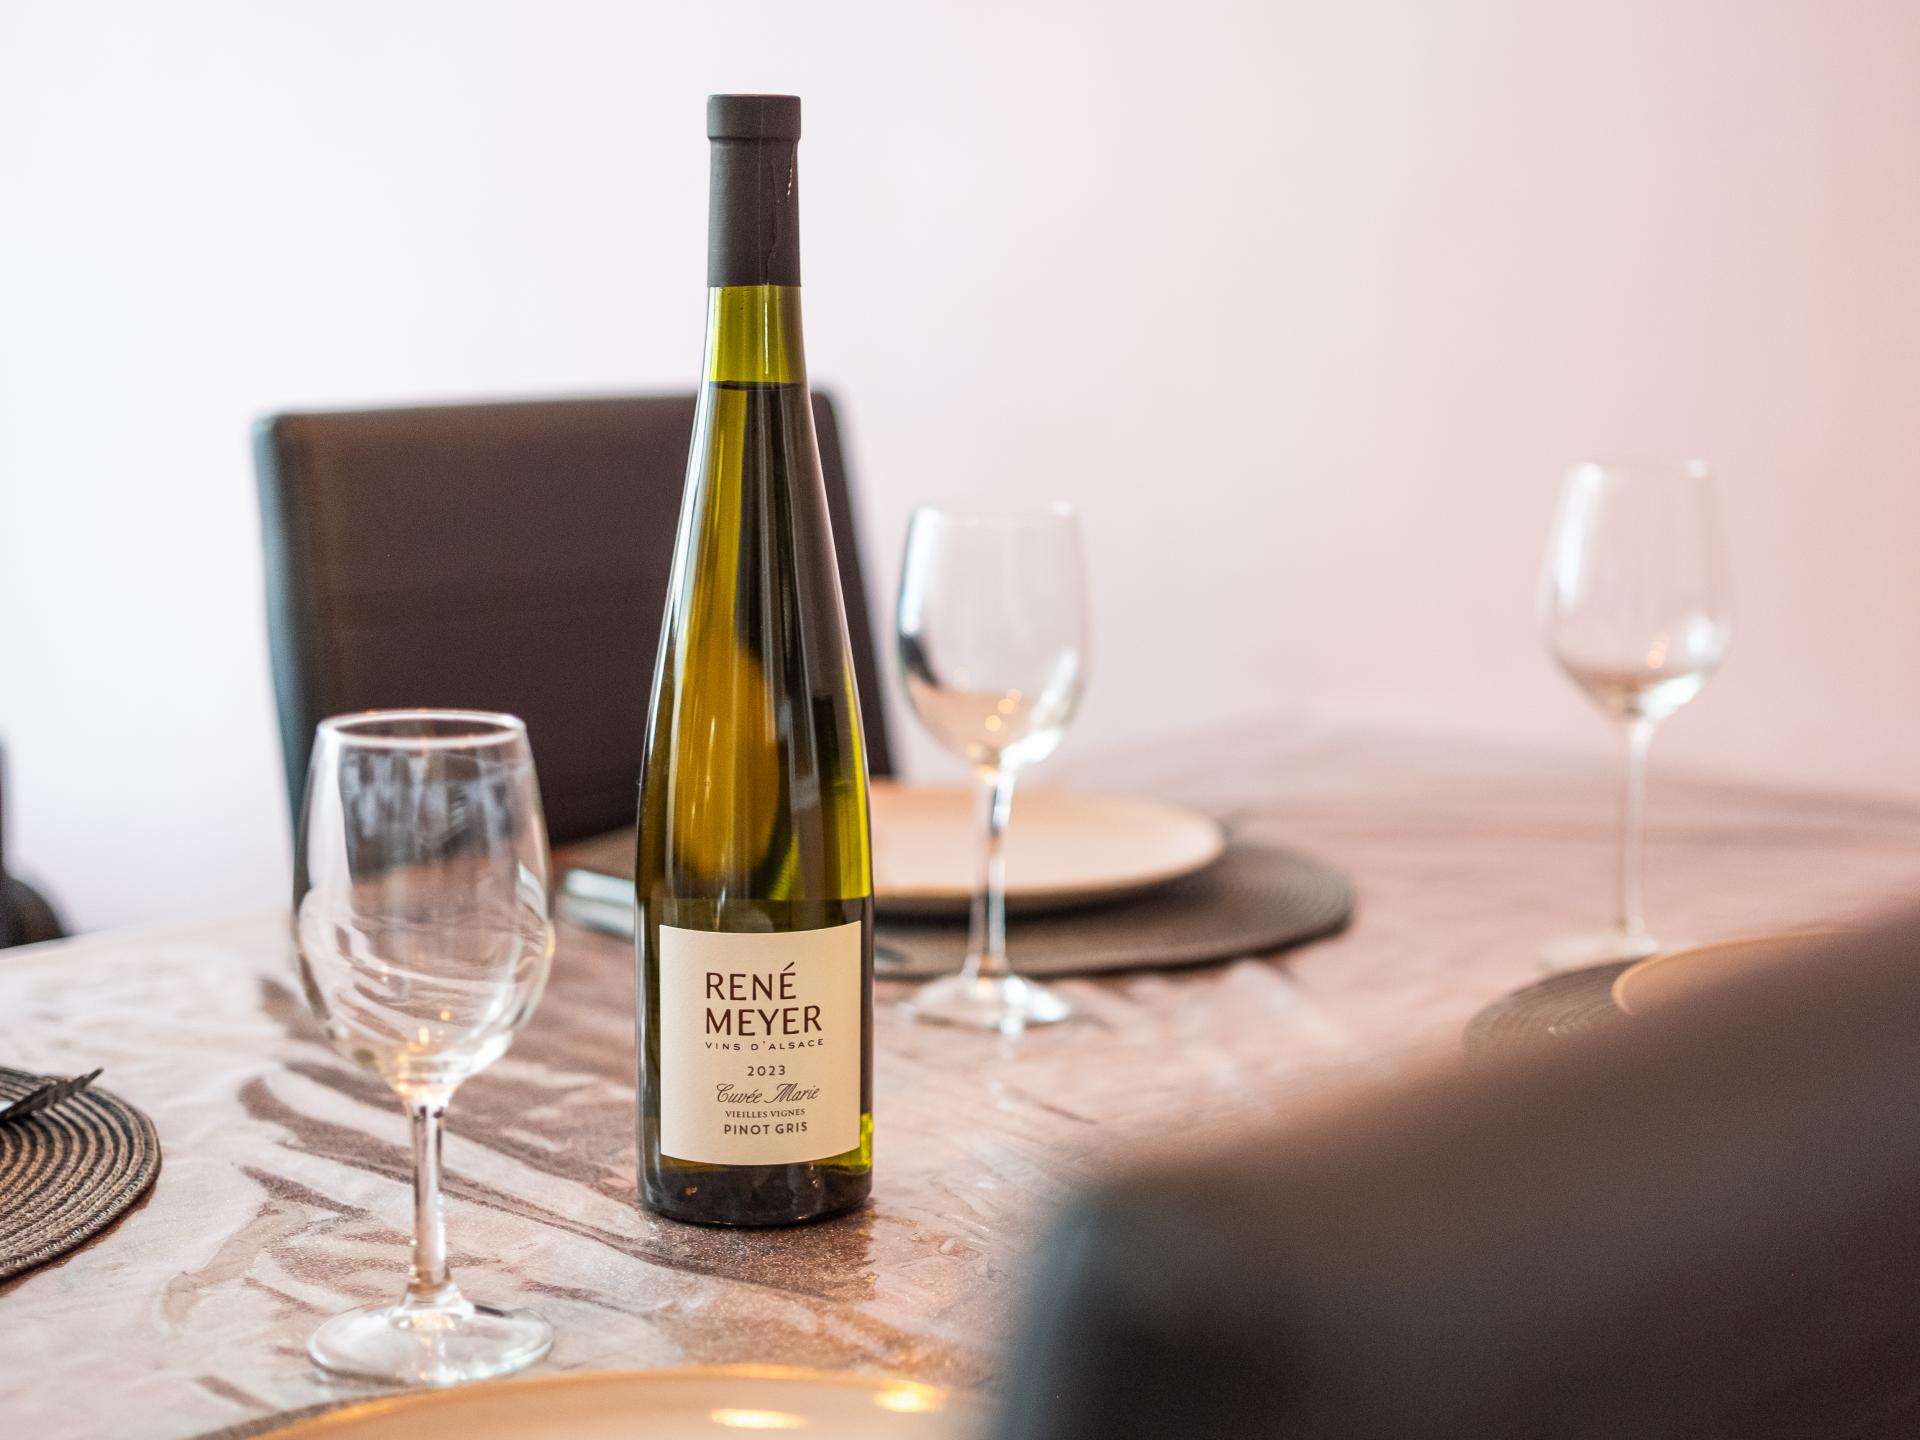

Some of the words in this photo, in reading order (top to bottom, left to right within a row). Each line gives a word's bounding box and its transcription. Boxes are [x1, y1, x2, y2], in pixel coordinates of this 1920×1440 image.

[705, 961, 797, 1001] RENÉ
[705, 1004, 823, 1037] MEYER
[704, 1041, 742, 1051] VINS
[750, 1037, 825, 1051] D'ALSACE
[746, 1064, 786, 1077] 2023
[716, 1082, 763, 1105] Cuvée
[764, 1082, 821, 1104] Marie
[725, 1110, 768, 1119] VIEILLES
[770, 1108, 806, 1118] VIGNES
[723, 1123, 771, 1136] PINOT
[774, 1121, 808, 1135] GRIS
